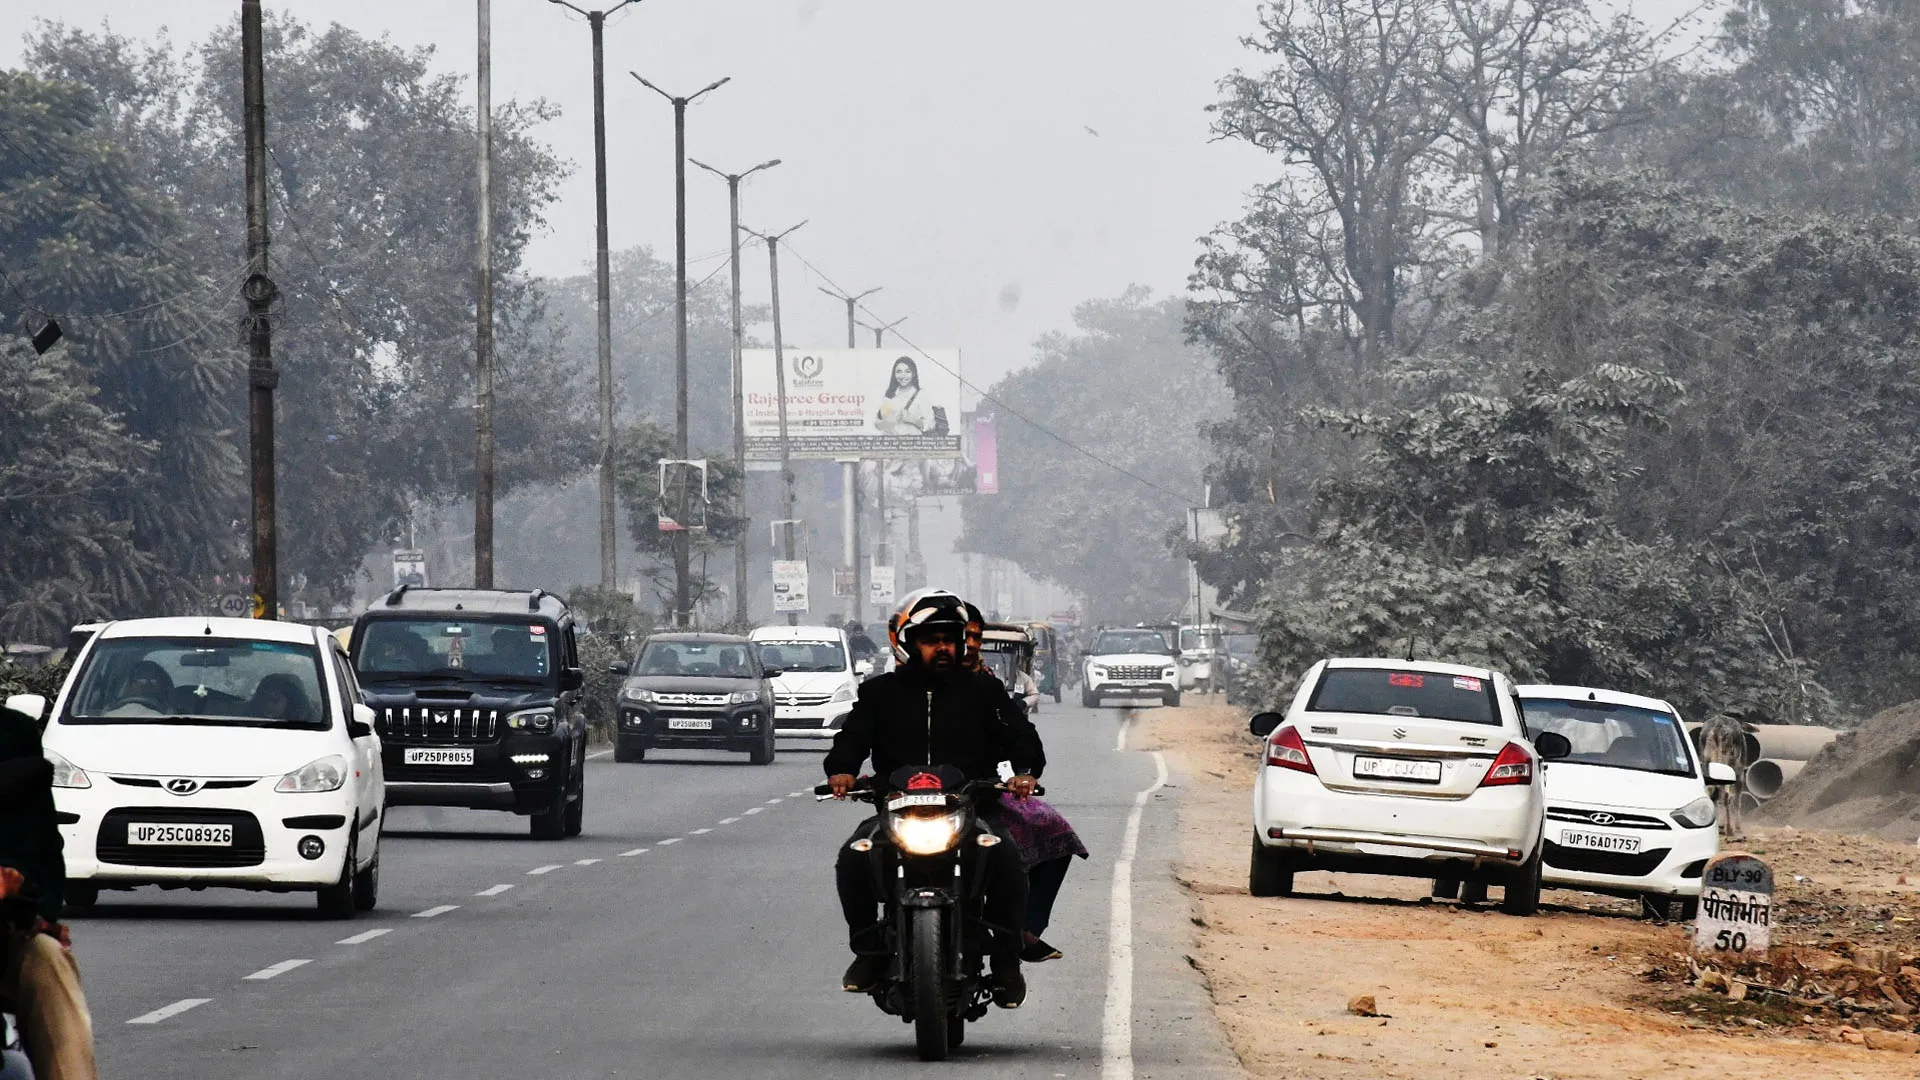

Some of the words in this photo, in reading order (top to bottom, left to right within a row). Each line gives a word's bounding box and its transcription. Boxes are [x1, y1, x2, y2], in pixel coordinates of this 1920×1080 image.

[225, 599, 245, 612] 40
[412, 752, 472, 762] UP25DP8055
[138, 827, 231, 842] UP25CQ8926
[1712, 867, 1762, 883] BLY-90
[1703, 891, 1770, 927] पीलीभीत
[1714, 929, 1747, 953] 50
